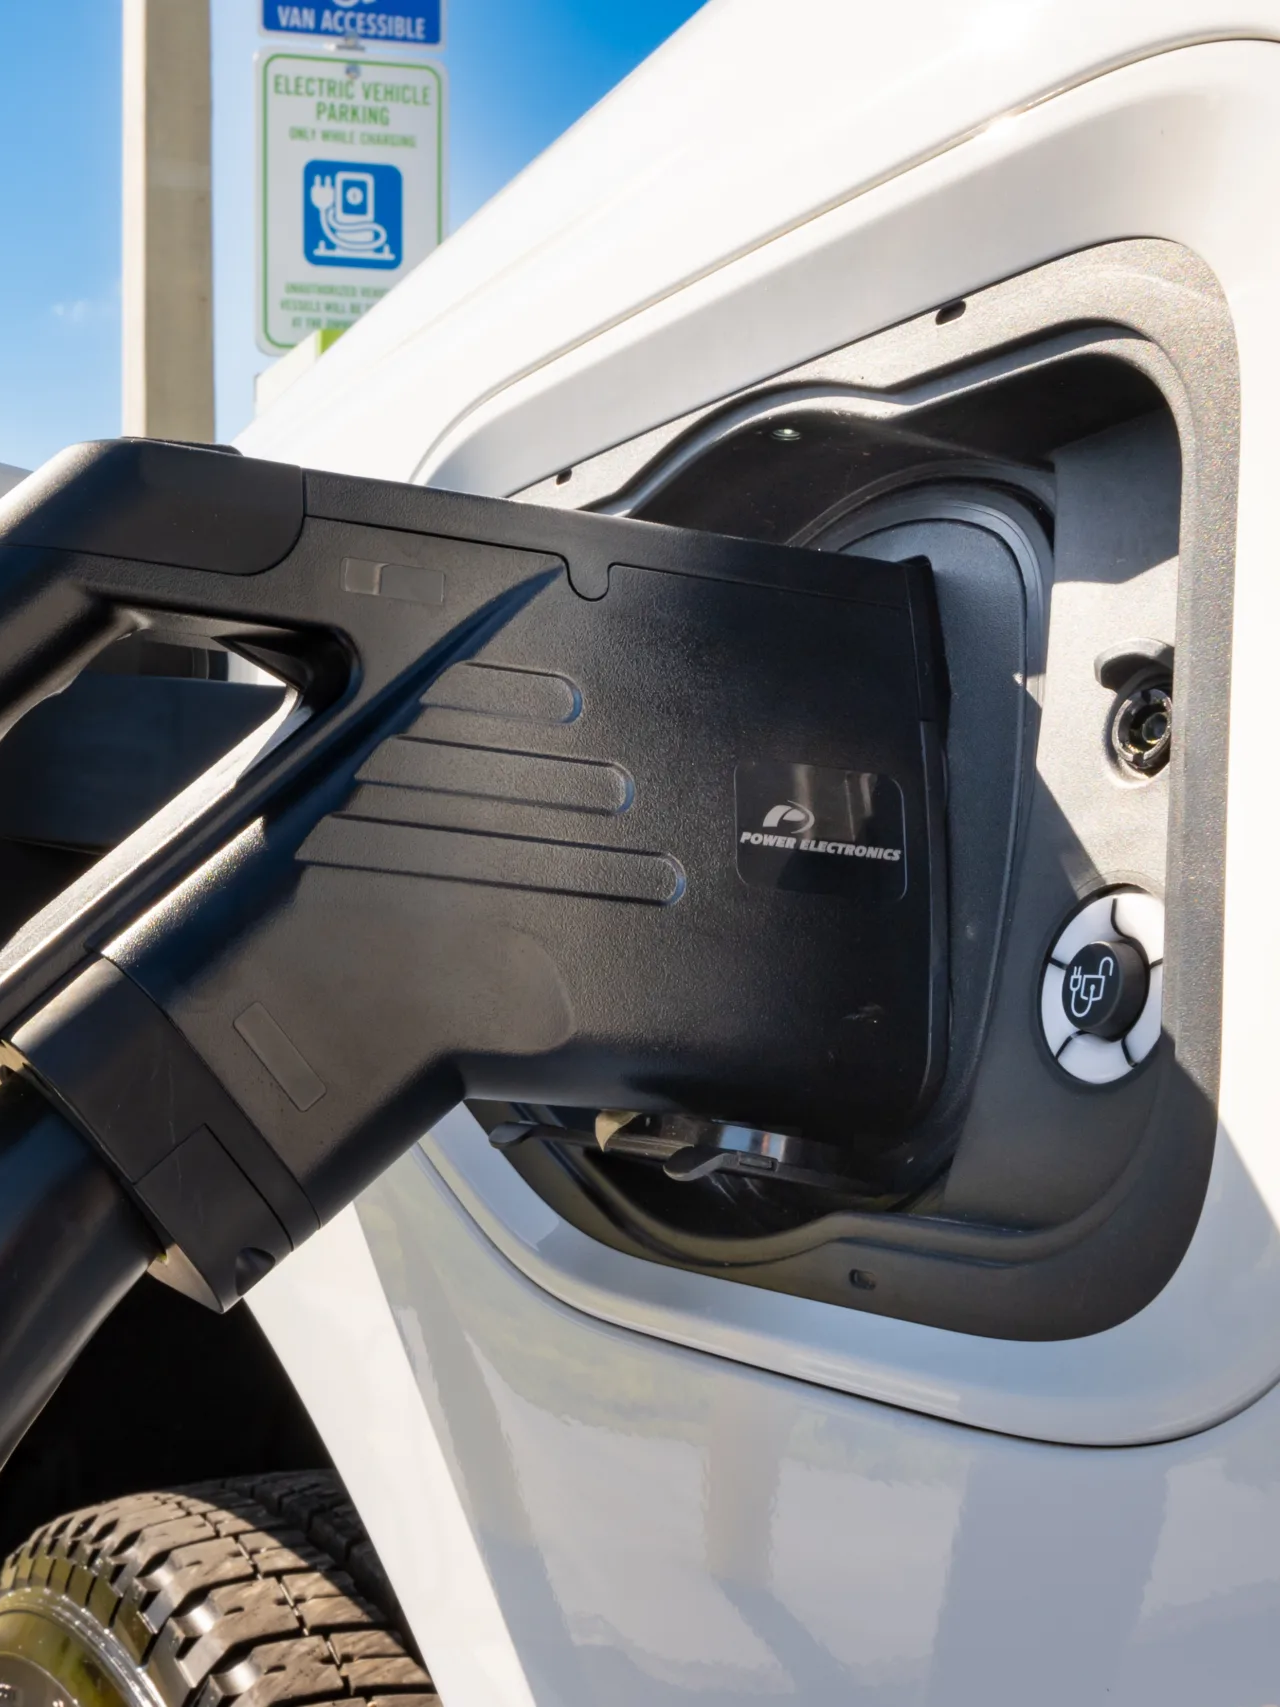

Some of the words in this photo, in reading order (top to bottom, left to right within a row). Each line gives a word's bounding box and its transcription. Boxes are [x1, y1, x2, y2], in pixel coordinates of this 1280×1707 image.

[277, 5, 315, 30] VAN
[321, 9, 426, 39] ACCESSIBLE
[274, 74, 355, 99] ELECTRIC
[361, 82, 431, 106] VEHICLE
[316, 101, 390, 126] PARKING
[288, 126, 316, 142] ONLY
[321, 129, 355, 145] WHILE
[359, 131, 417, 148] CHARGING
[740, 831, 796, 850] POWER
[799, 839, 902, 861] ELECTRONICS
